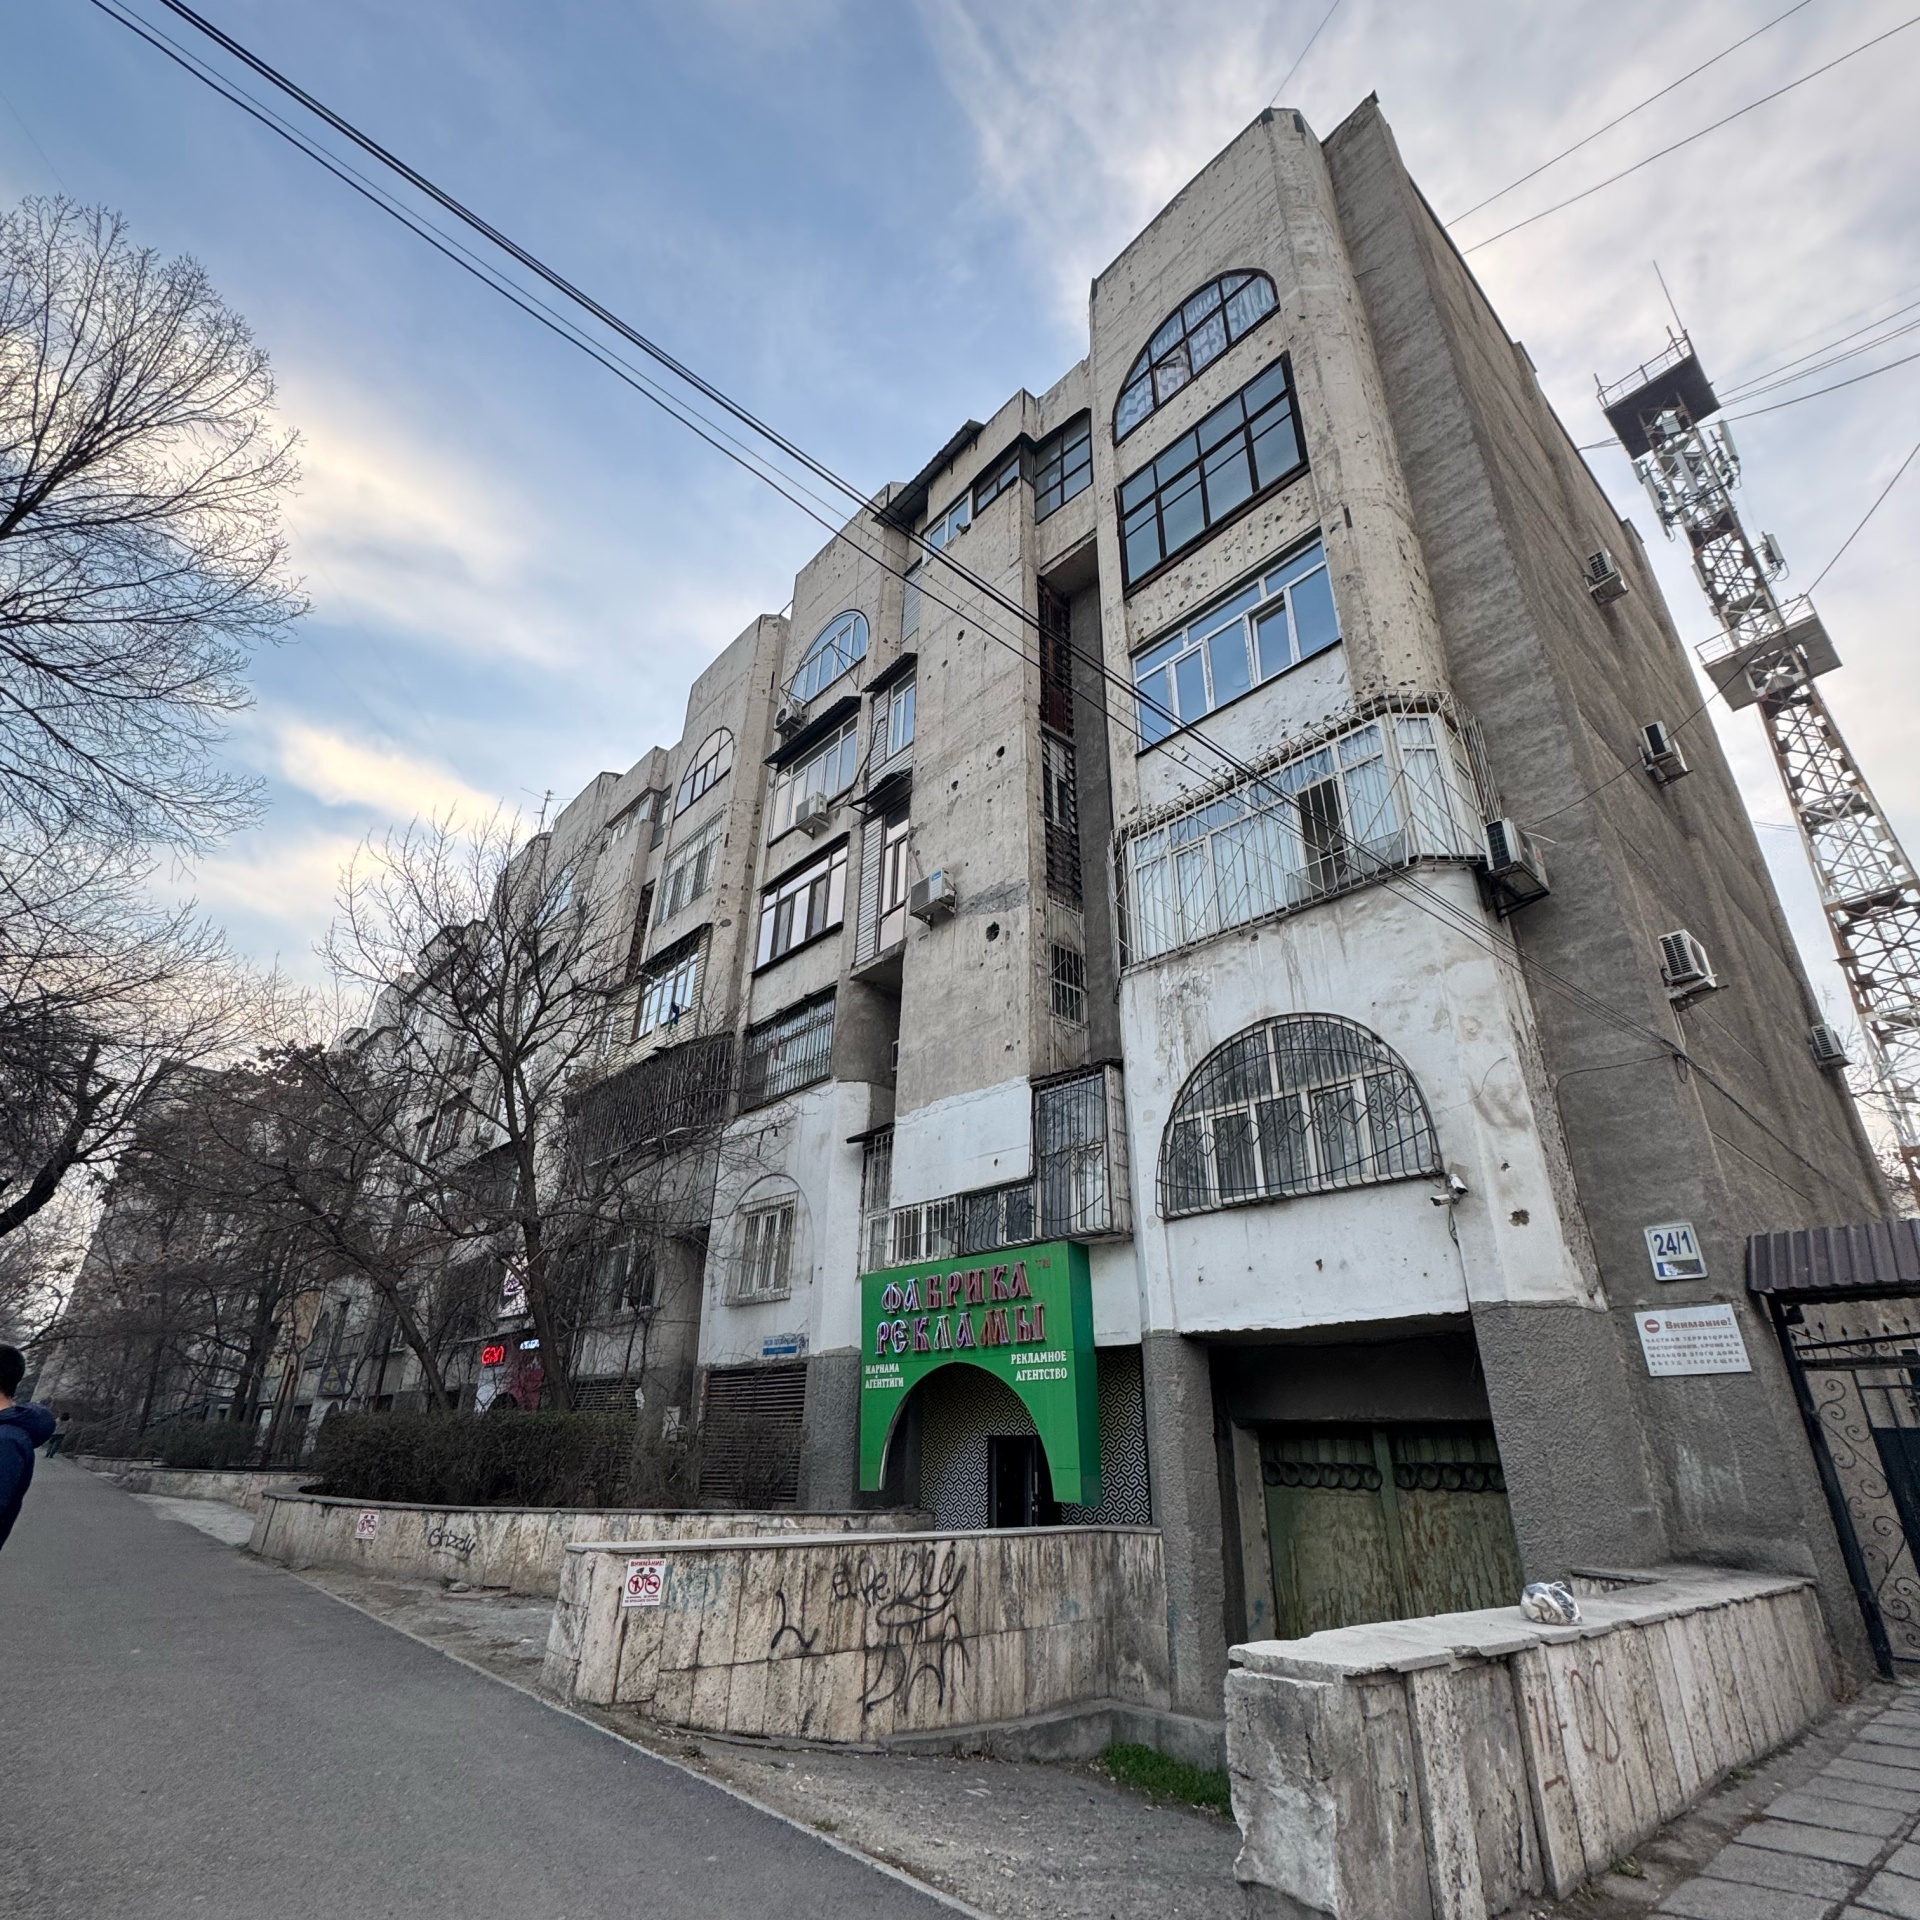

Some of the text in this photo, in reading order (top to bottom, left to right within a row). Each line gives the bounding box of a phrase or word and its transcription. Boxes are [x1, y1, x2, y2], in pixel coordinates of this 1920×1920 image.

[1653, 1230, 1693, 1256] 24/1
[881, 1260, 1032, 1314] ФАБРИКА
[875, 1303, 1046, 1355] РЕКЛАМЫ
[1664, 1317, 1732, 1330] Внимание!
[1010, 1350, 1067, 1365] РЕКЛАМНОЕ
[865, 1363, 900, 1374] ЖАРНАМА
[1015, 1367, 1068, 1382] АГЕНТСТВО
[865, 1377, 904, 1389] АГЕНТТИГИ
